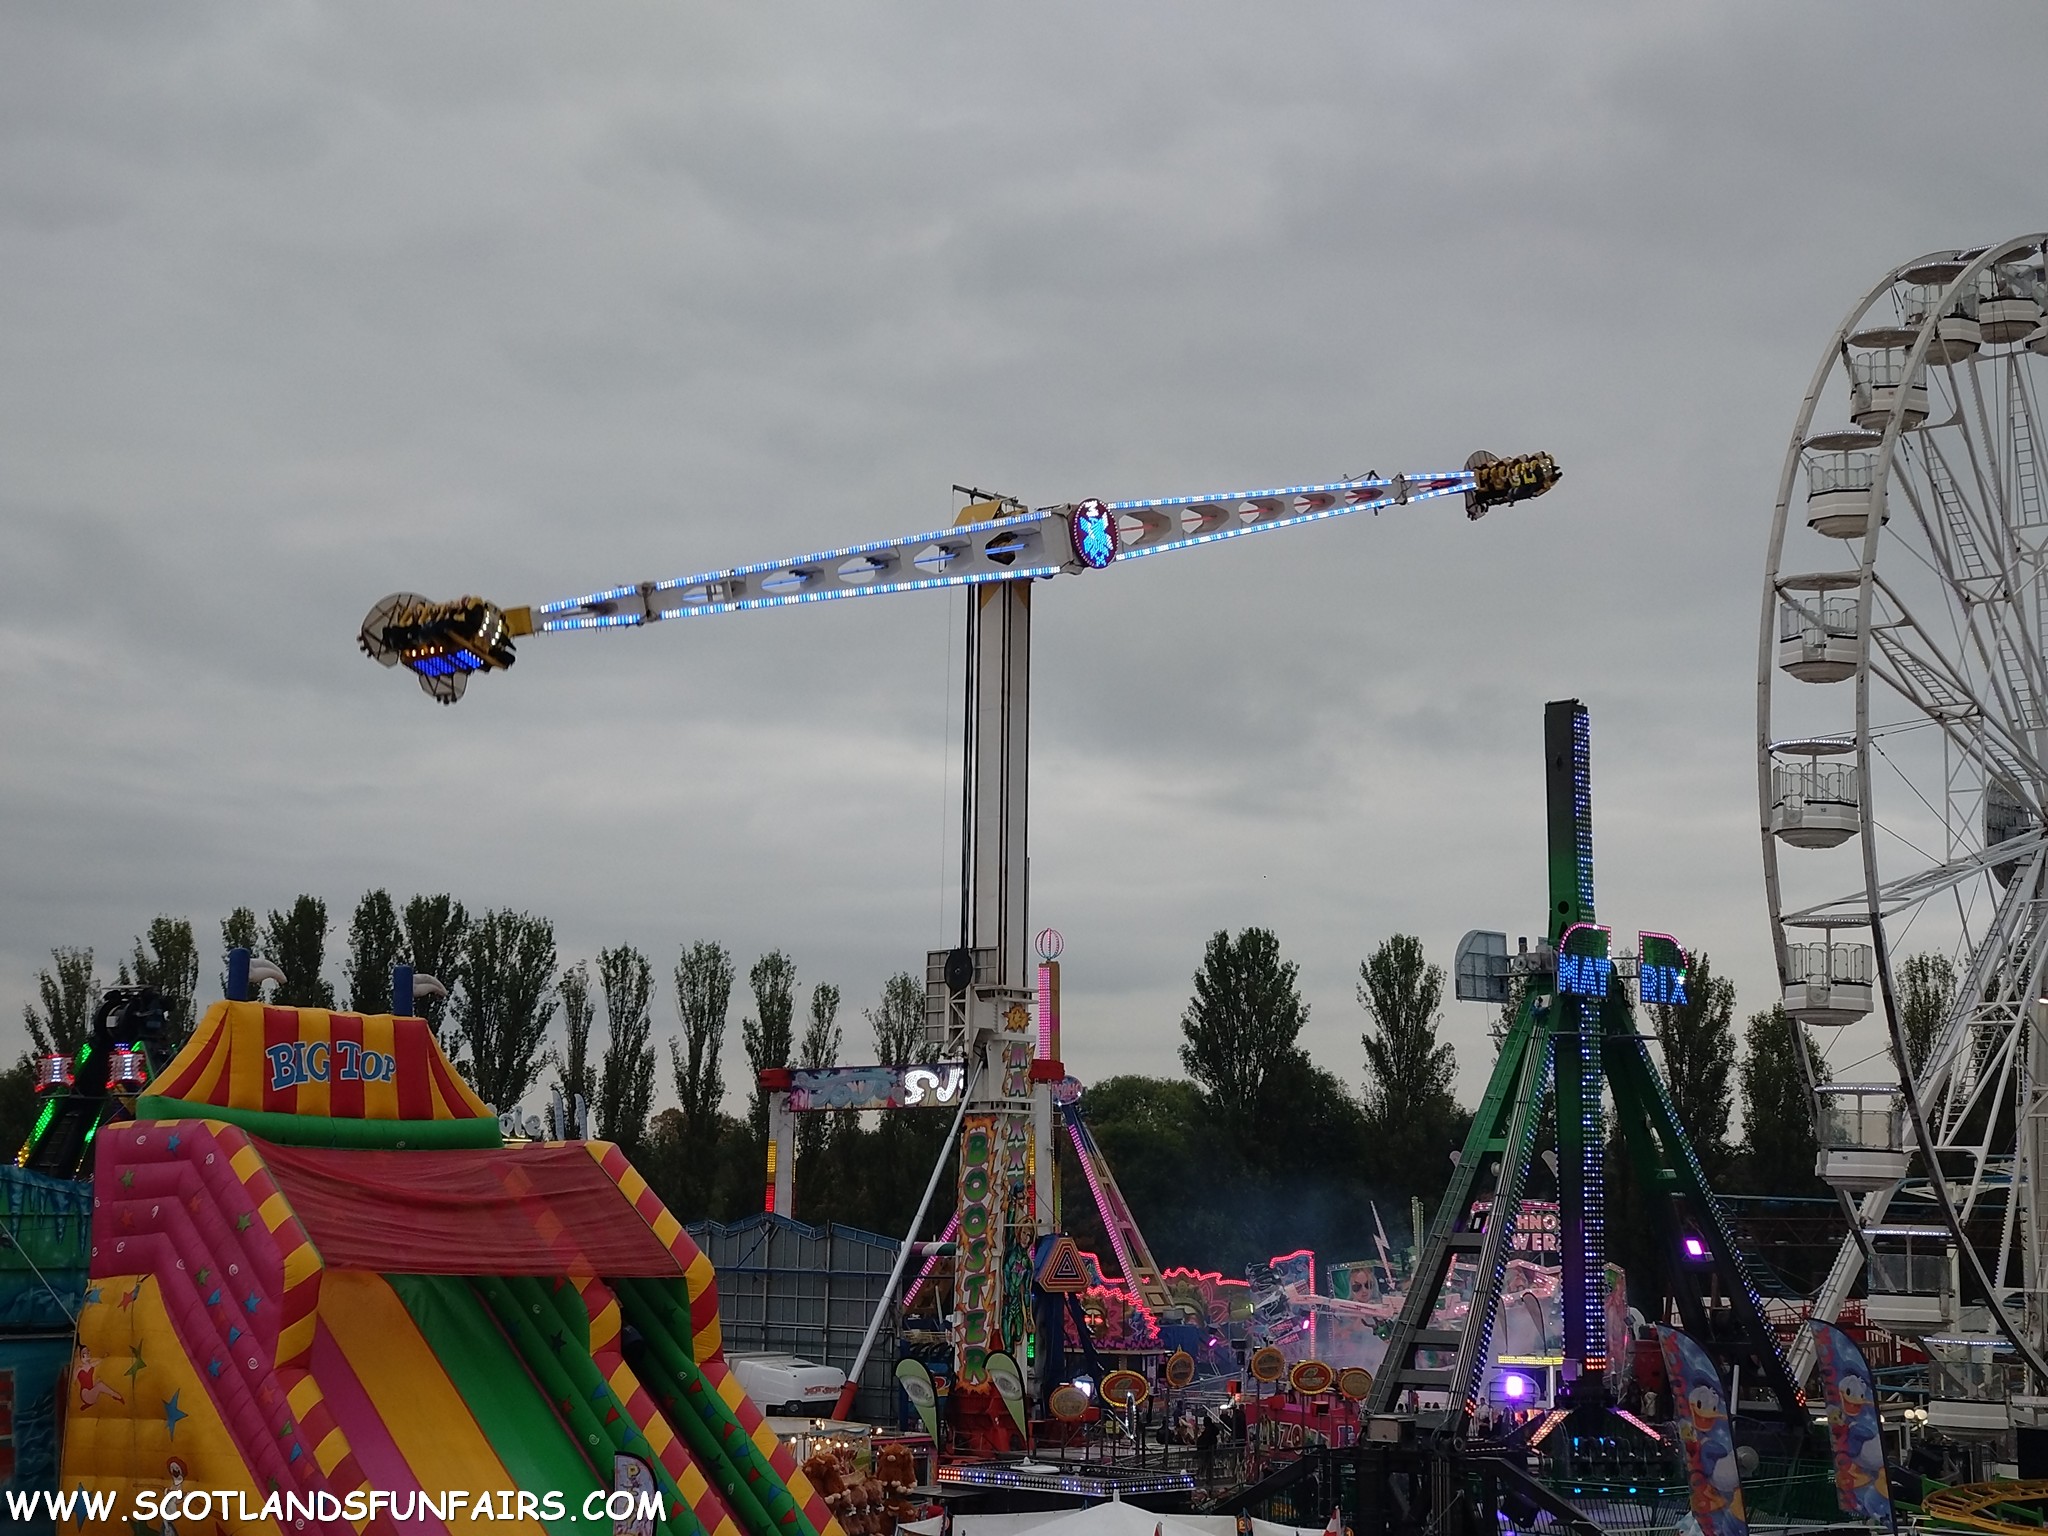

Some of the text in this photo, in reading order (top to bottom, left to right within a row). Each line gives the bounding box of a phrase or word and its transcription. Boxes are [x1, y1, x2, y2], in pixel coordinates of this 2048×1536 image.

[1559, 953, 1688, 1005] MAT RIX
[266, 1041, 331, 1092] BIG
[962, 1131, 989, 1384] BOOSTER
